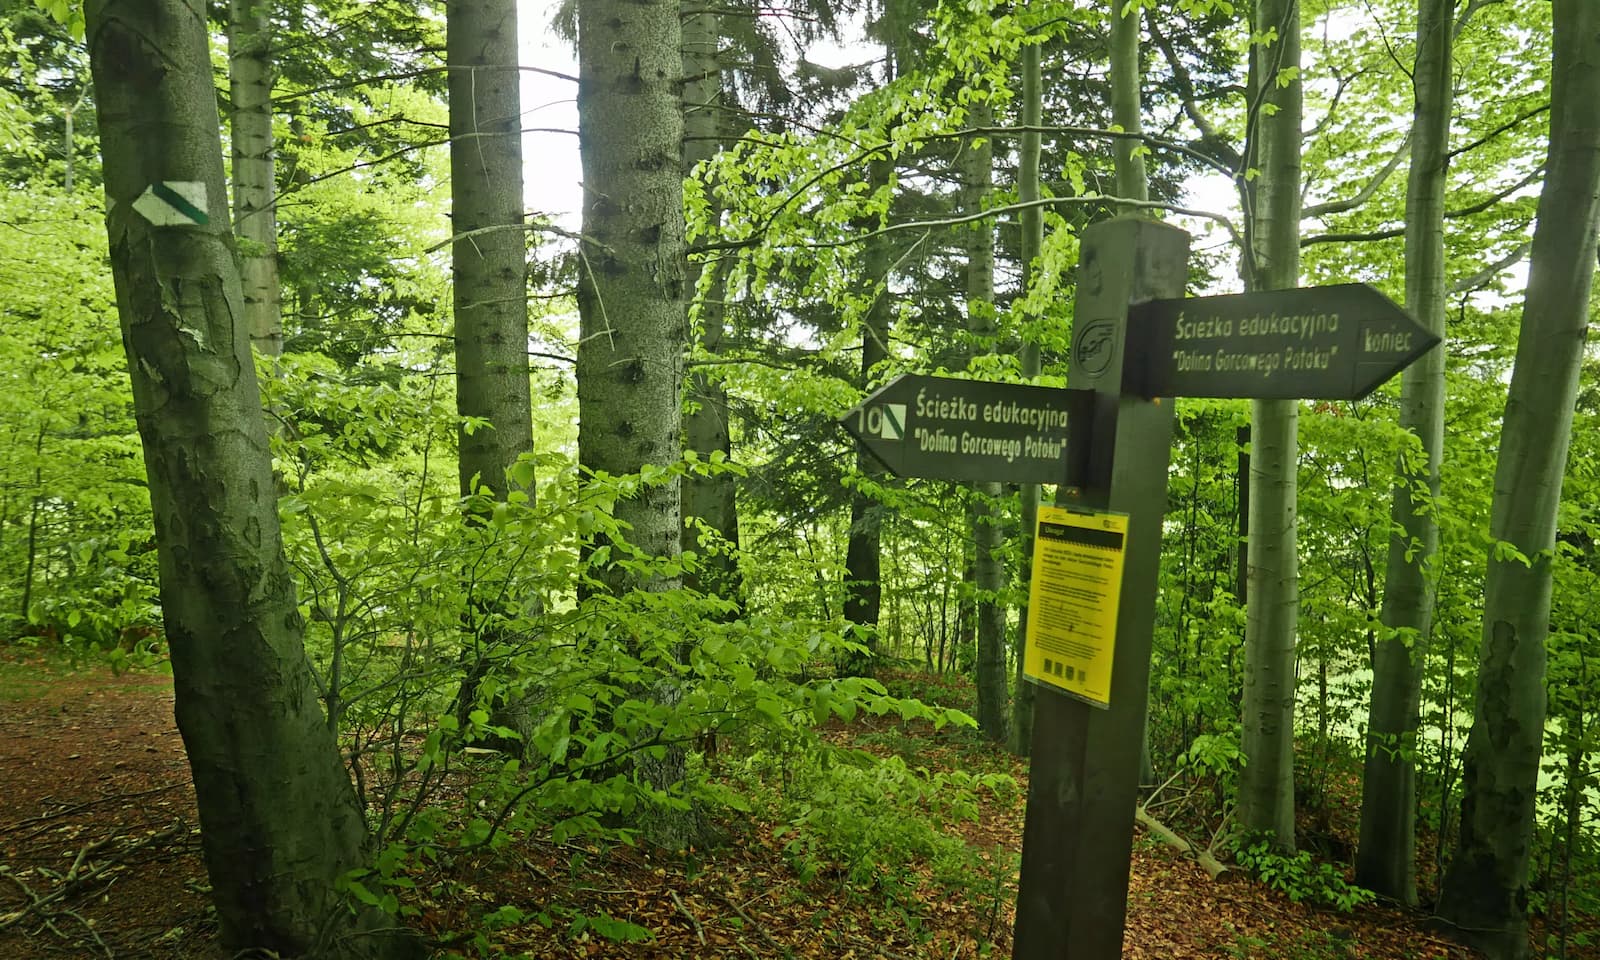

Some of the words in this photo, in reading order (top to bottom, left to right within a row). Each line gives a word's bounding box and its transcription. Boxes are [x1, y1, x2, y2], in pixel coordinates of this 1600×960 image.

[1239, 310, 1339, 339] edukacyjna
[1365, 325, 1411, 352] koniec
[1215, 349, 1279, 377] Gorcowego
[857, 407, 882, 434] 10
[916, 387, 977, 421] Ścieżka
[983, 398, 1069, 431] edukacyjna
[961, 431, 1021, 463] Gorcowego
